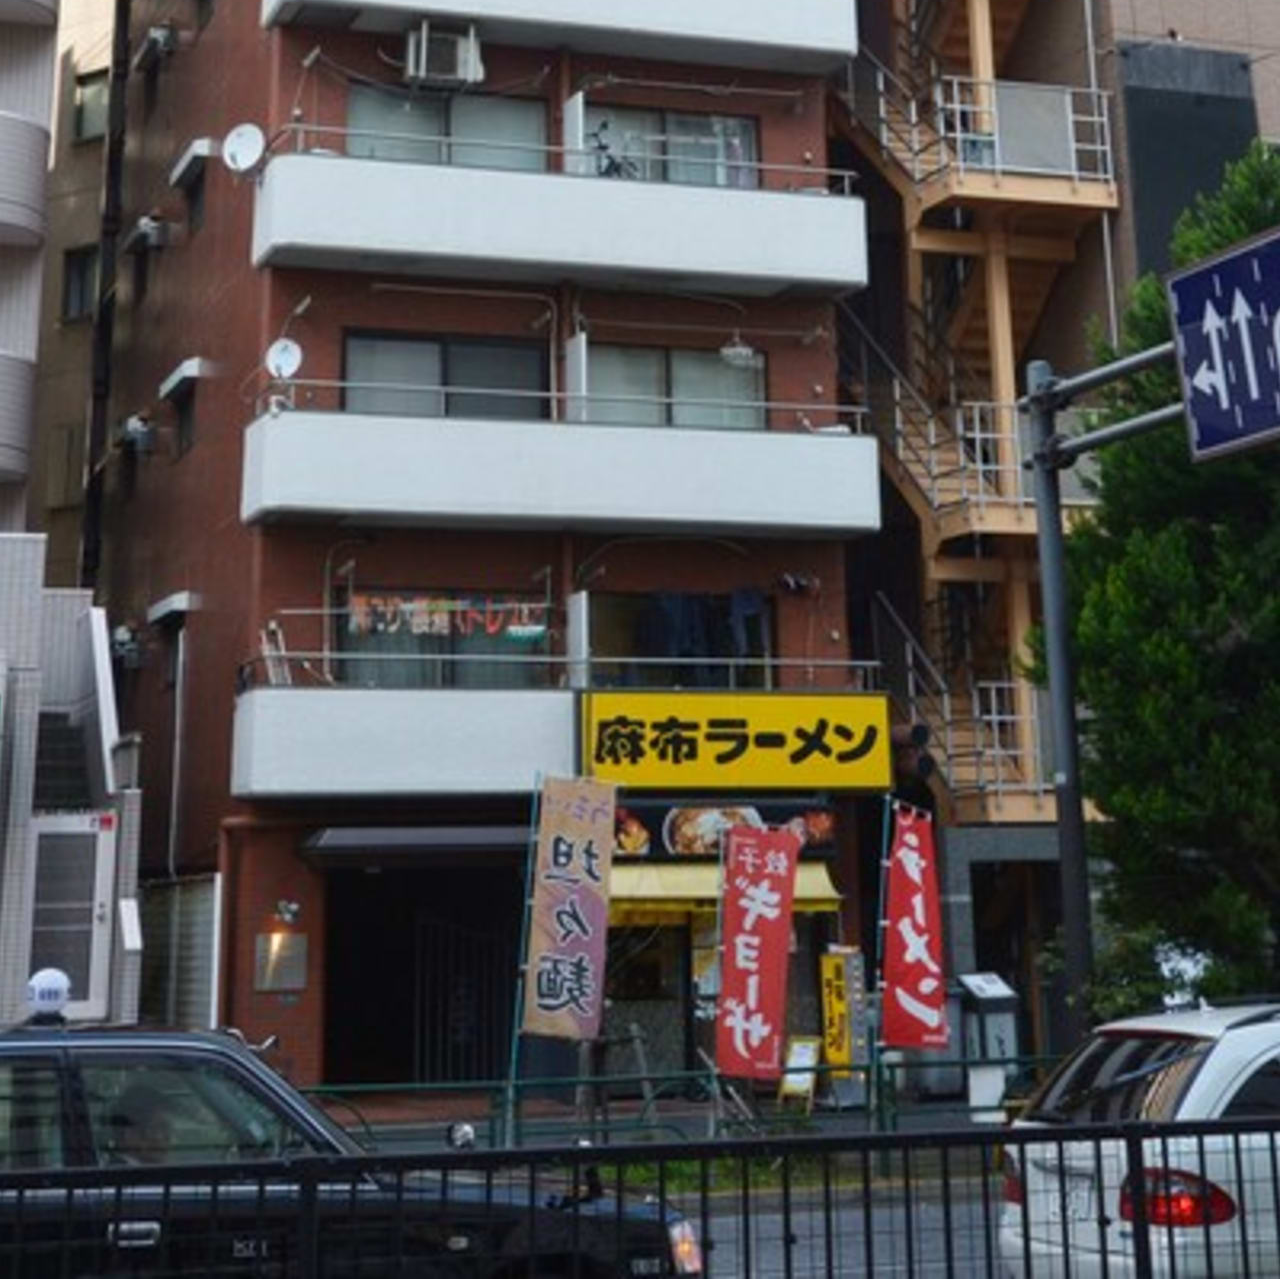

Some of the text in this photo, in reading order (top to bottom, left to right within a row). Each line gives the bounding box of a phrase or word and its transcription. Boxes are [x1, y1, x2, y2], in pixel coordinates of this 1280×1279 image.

[594, 715, 878, 765] 麻布ラーメン
